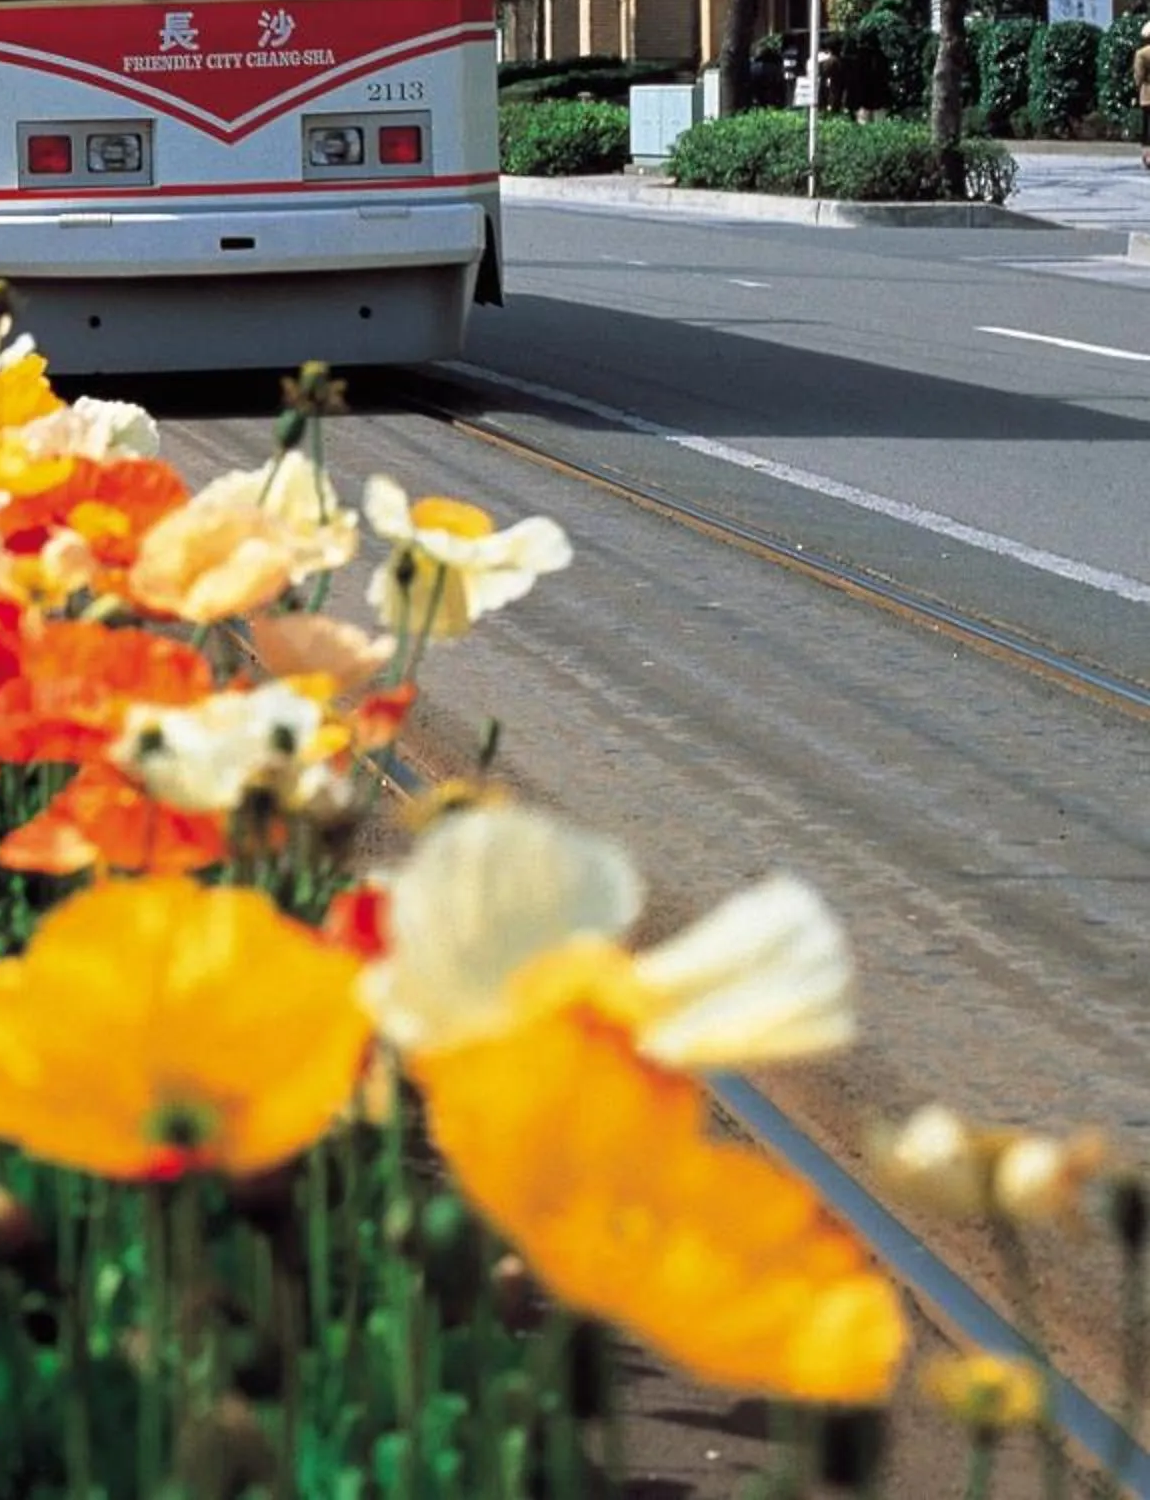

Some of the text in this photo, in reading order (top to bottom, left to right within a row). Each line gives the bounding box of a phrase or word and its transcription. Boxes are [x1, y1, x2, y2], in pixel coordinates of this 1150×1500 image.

[123, 53, 203, 73] FRIENDLY
[206, 53, 242, 70] CITY
[367, 82, 425, 102] 2113
